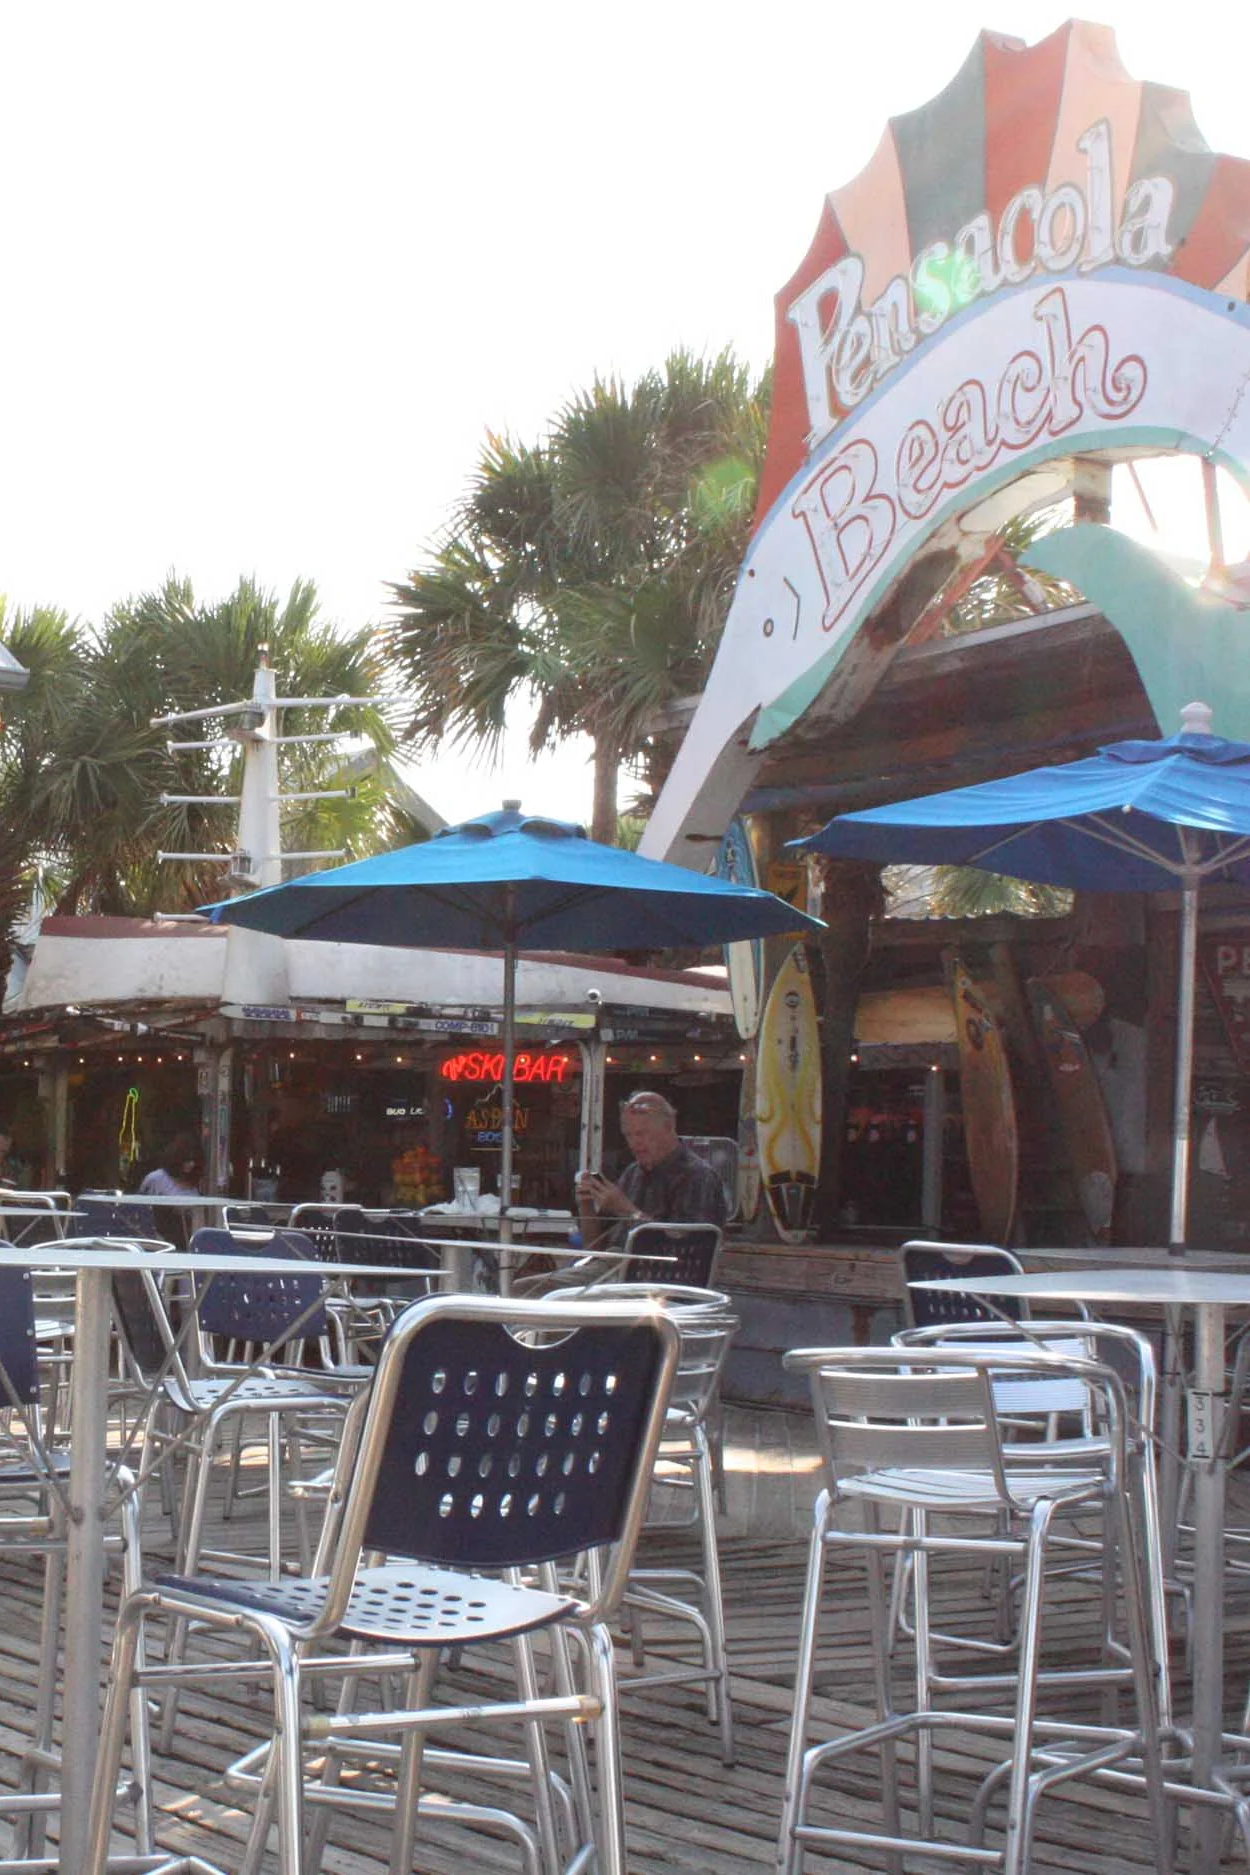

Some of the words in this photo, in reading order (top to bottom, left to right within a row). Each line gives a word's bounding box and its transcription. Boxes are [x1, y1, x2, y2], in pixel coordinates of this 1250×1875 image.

[787, 117, 1177, 443] Pensacola
[791, 286, 1148, 632] Beach
[464, 1052, 505, 1081] SKI
[512, 1053, 570, 1082] BAR
[465, 1107, 528, 1131] ASPN
